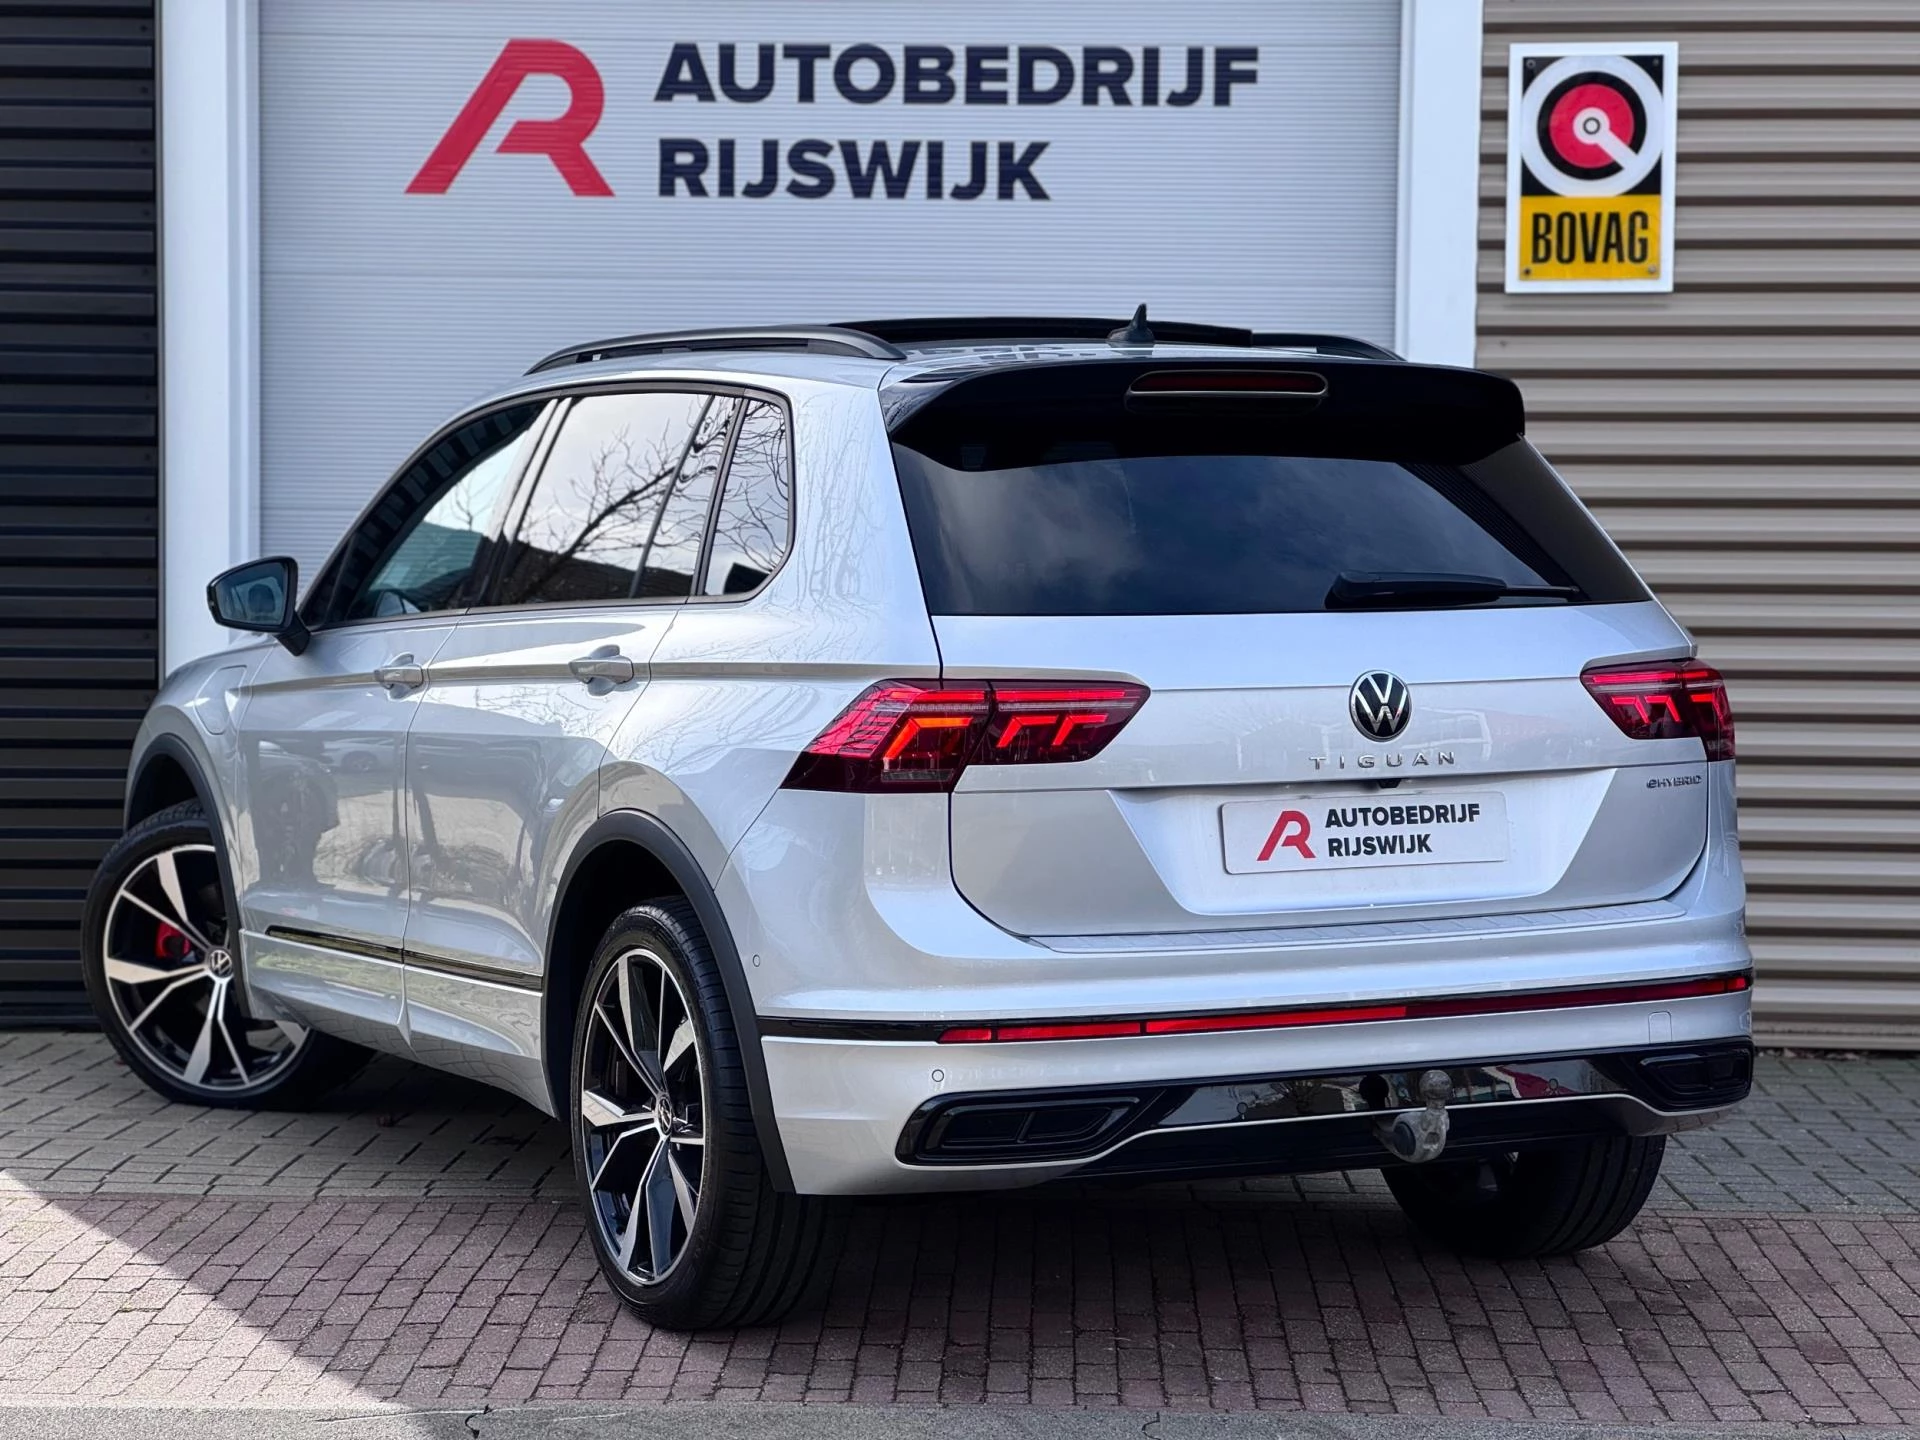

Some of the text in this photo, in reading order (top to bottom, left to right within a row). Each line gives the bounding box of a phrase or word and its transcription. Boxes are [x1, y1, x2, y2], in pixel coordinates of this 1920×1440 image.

[654, 43, 1260, 107] AUTOBEDRIJF
[658, 139, 1052, 201] RIJSWIJK
[1531, 211, 1648, 264] BOVAG
[1308, 751, 1455, 770] TIGUAN
[1325, 803, 1481, 828] AUTOBEDRIJF
[1327, 833, 1433, 857] RIJSWIJK
